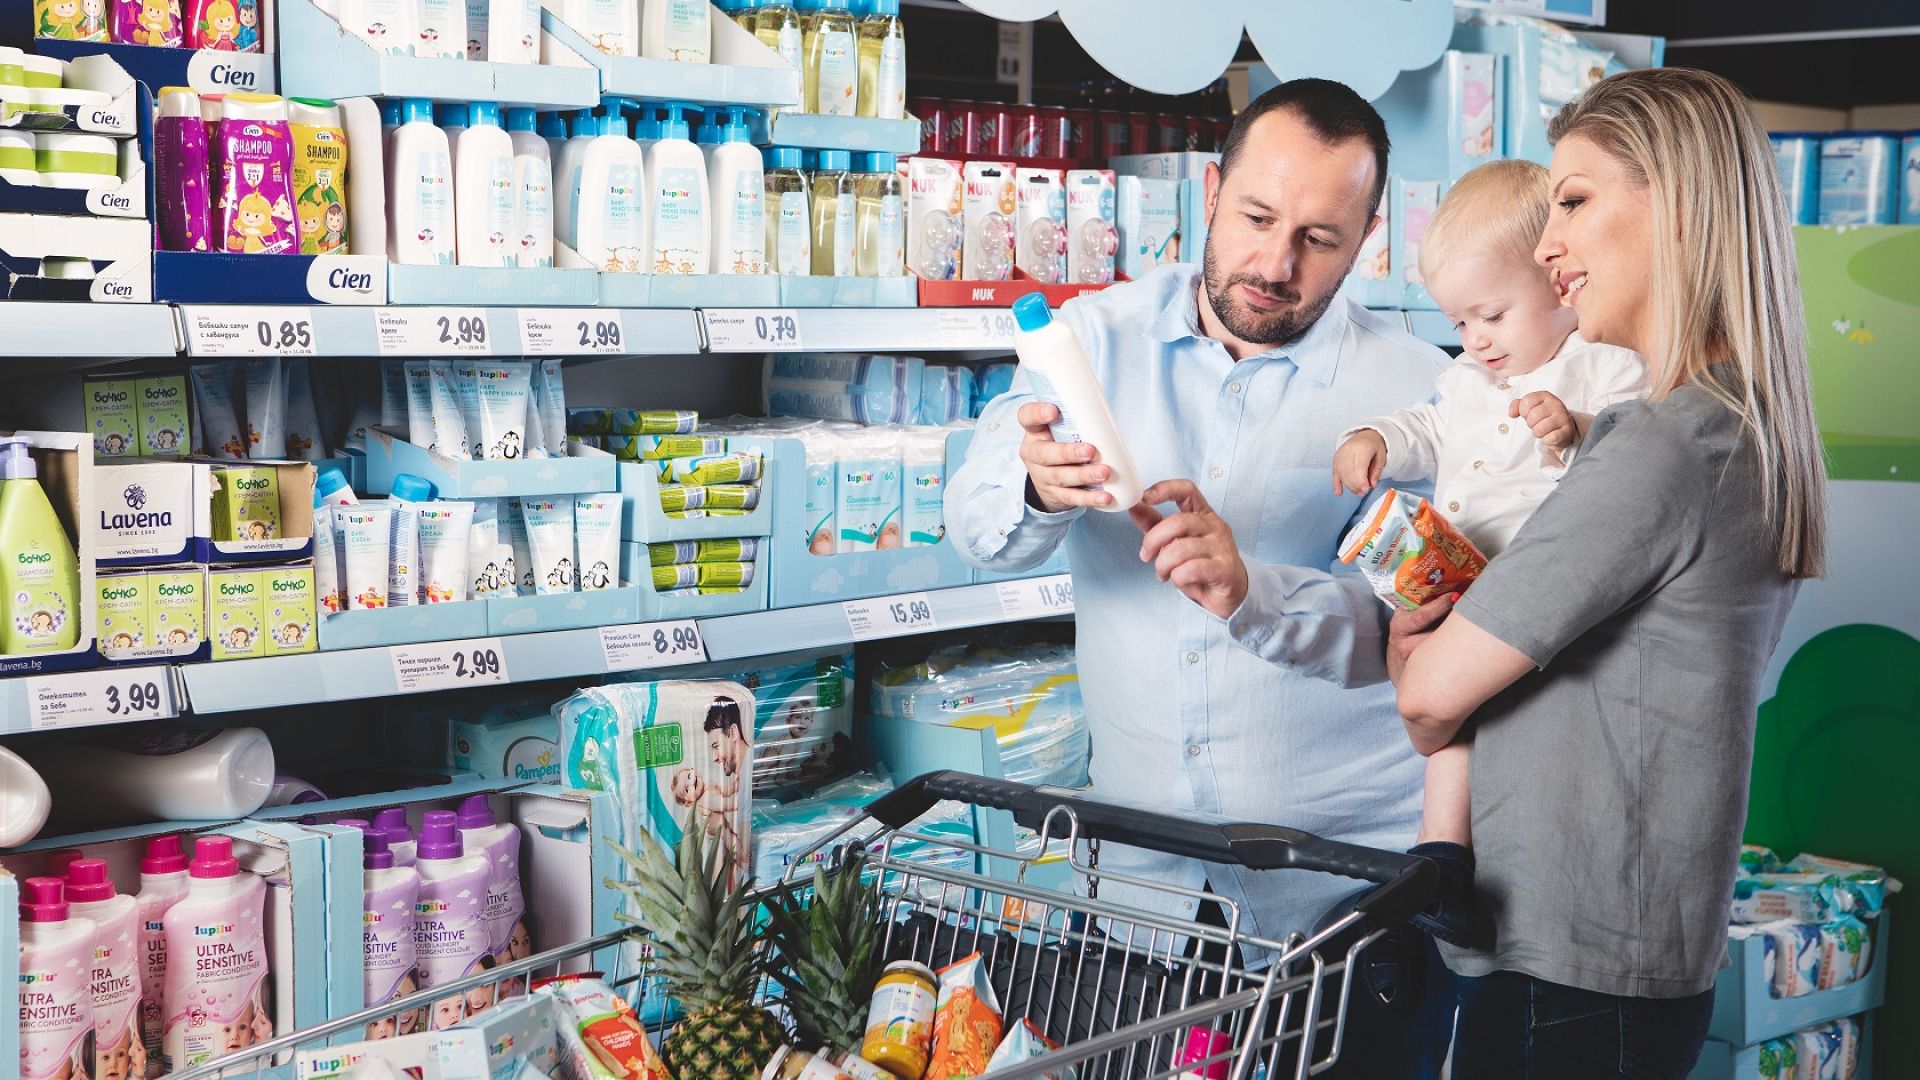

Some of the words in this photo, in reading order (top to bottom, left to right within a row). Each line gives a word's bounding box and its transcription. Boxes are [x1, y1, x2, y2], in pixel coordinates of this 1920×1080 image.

[210, 64, 256, 87] Cien
[233, 140, 272, 154] SHAMPOO
[911, 178, 937, 192] NUK
[967, 181, 993, 197] NUK
[662, 188, 690, 198] lupilu
[101, 193, 130, 209] Cien
[329, 268, 372, 290] Cien
[103, 281, 133, 296] Cien
[972, 287, 996, 301] NUK
[436, 316, 486, 346] 2,99
[755, 315, 797, 342] 0,79
[980, 314, 1016, 339] 3,99
[257, 320, 311, 349] 0,85
[577, 320, 621, 348] 2,99
[480, 370, 509, 379] lupilu
[237, 478, 270, 491] бочко
[847, 473, 874, 483] lupilu
[916, 477, 942, 486] lupilu
[526, 502, 555, 511] lupilu
[577, 501, 605, 510] lupilu
[101, 510, 172, 530] Lavena
[350, 515, 375, 524] lupilu
[421, 510, 452, 518] lupilu
[18, 552, 51, 565] бочко
[1371, 551, 1384, 565] BIO
[158, 583, 194, 596] бочко
[220, 583, 255, 596] бочко
[272, 579, 306, 592] бочко
[102, 587, 138, 600] бочко
[889, 600, 930, 624] 15,99
[653, 626, 699, 655] 8,99
[452, 648, 499, 679] 2,99
[105, 681, 160, 716] 3,99
[515, 762, 561, 781] Pampers
[415, 902, 449, 912] upilu
[195, 924, 233, 937] lupilu
[197, 943, 235, 957] ULTRA
[196, 950, 254, 971] SENSITIVE
[196, 968, 222, 979] FABRIC
[222, 960, 260, 976] CONDITIONER
[19, 973, 57, 985] upilu
[91, 975, 131, 995] NSITIVE
[19, 1003, 77, 1020] ENSITIVE
